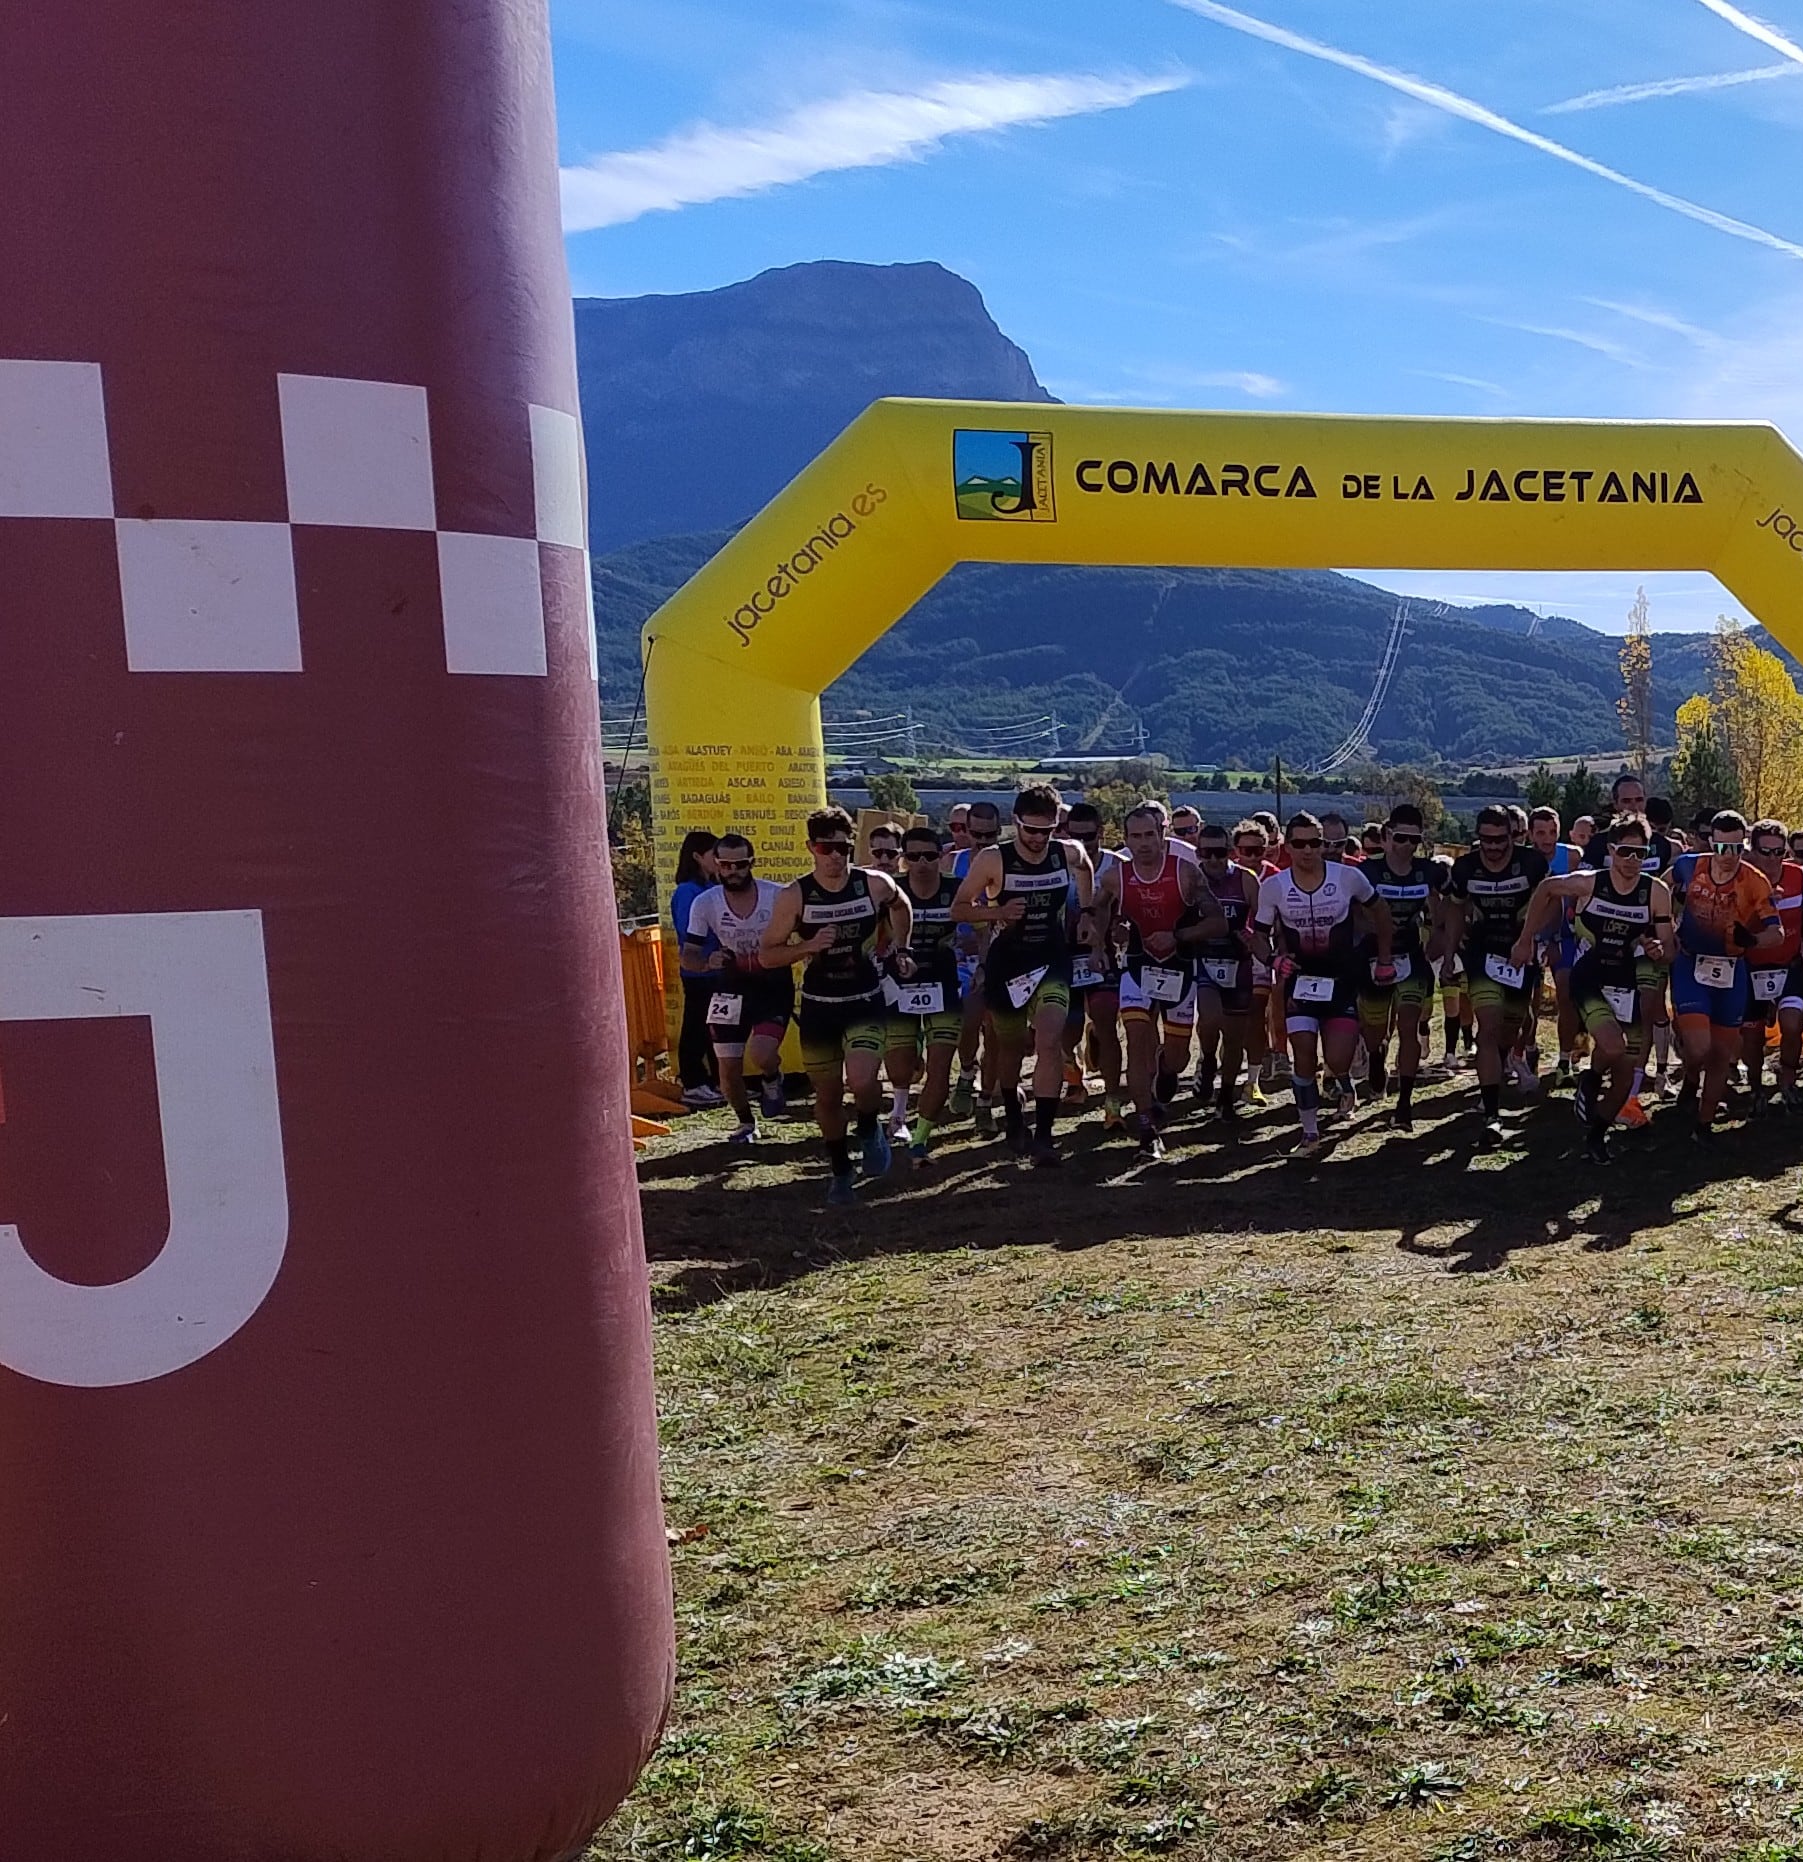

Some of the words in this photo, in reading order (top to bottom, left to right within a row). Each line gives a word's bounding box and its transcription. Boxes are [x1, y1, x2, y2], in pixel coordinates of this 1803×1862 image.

[1075, 459, 1318, 499] COMARCA
[1342, 474, 1382, 500] DE
[1393, 475, 1436, 500] LA
[1454, 469, 1705, 503] JACETANIA
[1711, 967, 1721, 979] 5
[1156, 979, 1165, 991] 7
[1310, 982, 1318, 993] 1
[1766, 980, 1776, 992] 9
[910, 994, 931, 1006] 40
[712, 1003, 729, 1016] 24
